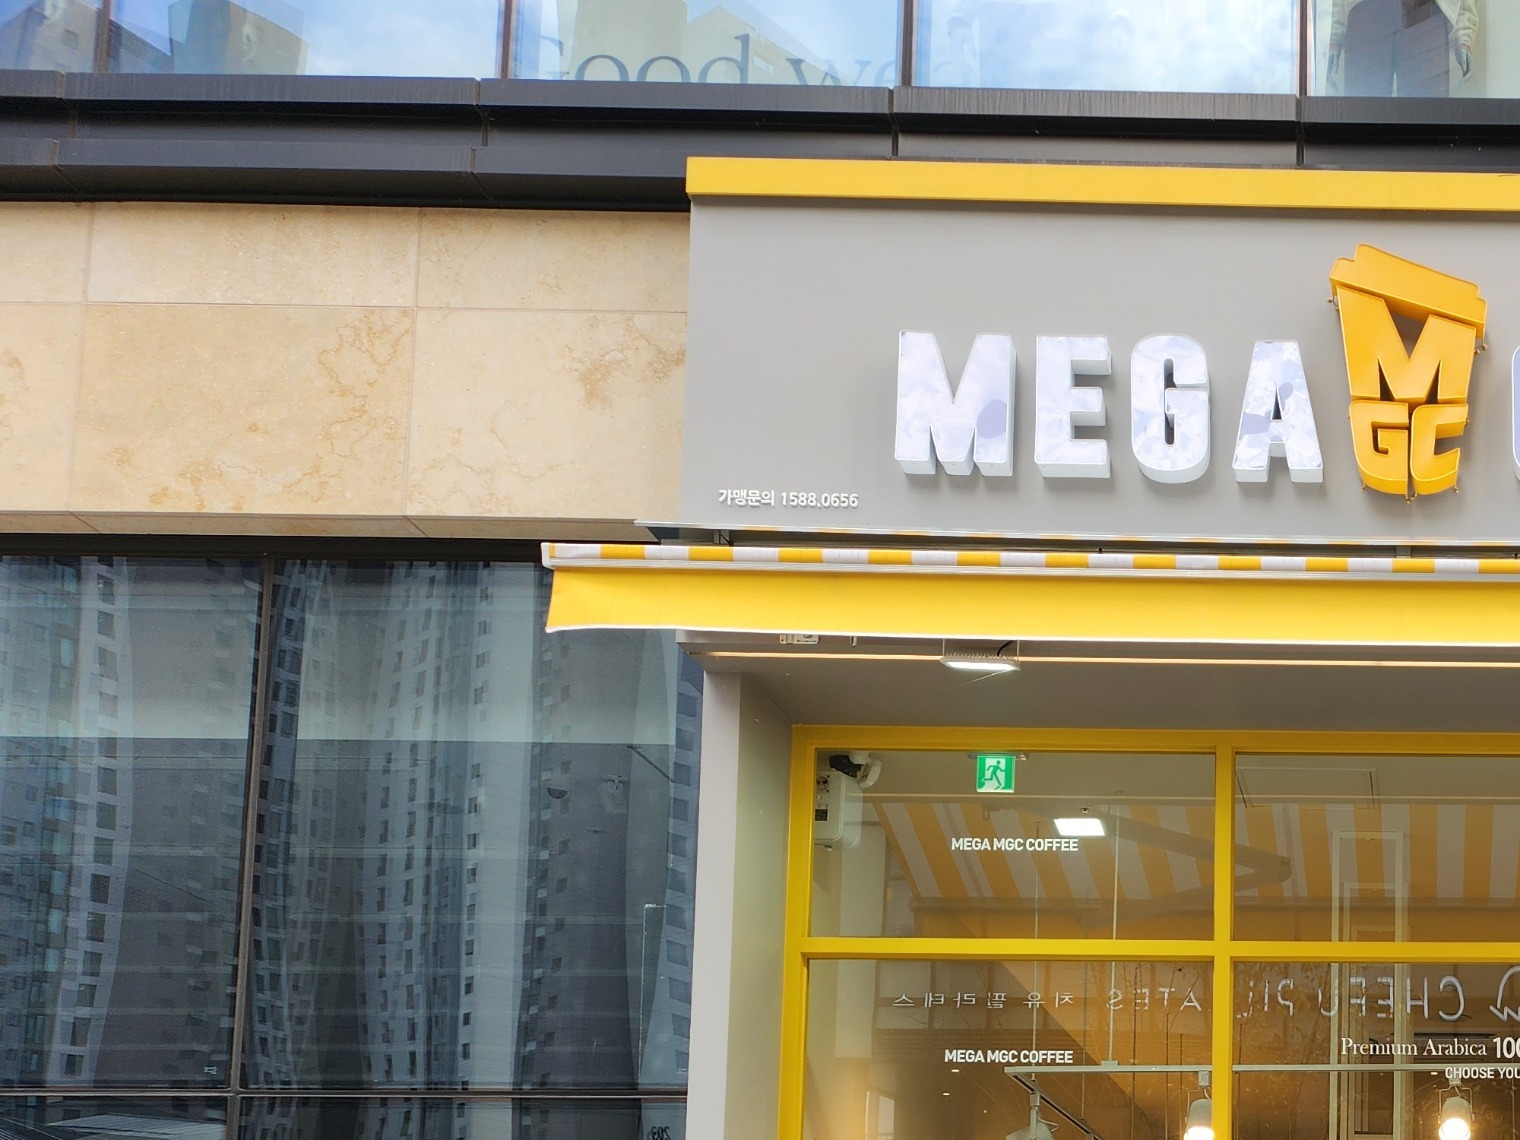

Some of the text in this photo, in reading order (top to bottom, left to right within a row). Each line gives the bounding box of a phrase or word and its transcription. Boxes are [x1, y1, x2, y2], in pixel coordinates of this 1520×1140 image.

[894, 329, 1324, 483] MEGA
[718, 487, 775, 507] 가맹문의
[951, 838, 1079, 851] MEGA MGC COFFEE
[1340, 1037, 1418, 1057] Premium
[1423, 1037, 1488, 1057] Arabica
[944, 1049, 1073, 1063] MEGA MGC COFFEE
[1445, 1066, 1494, 1079] CHOOSE
